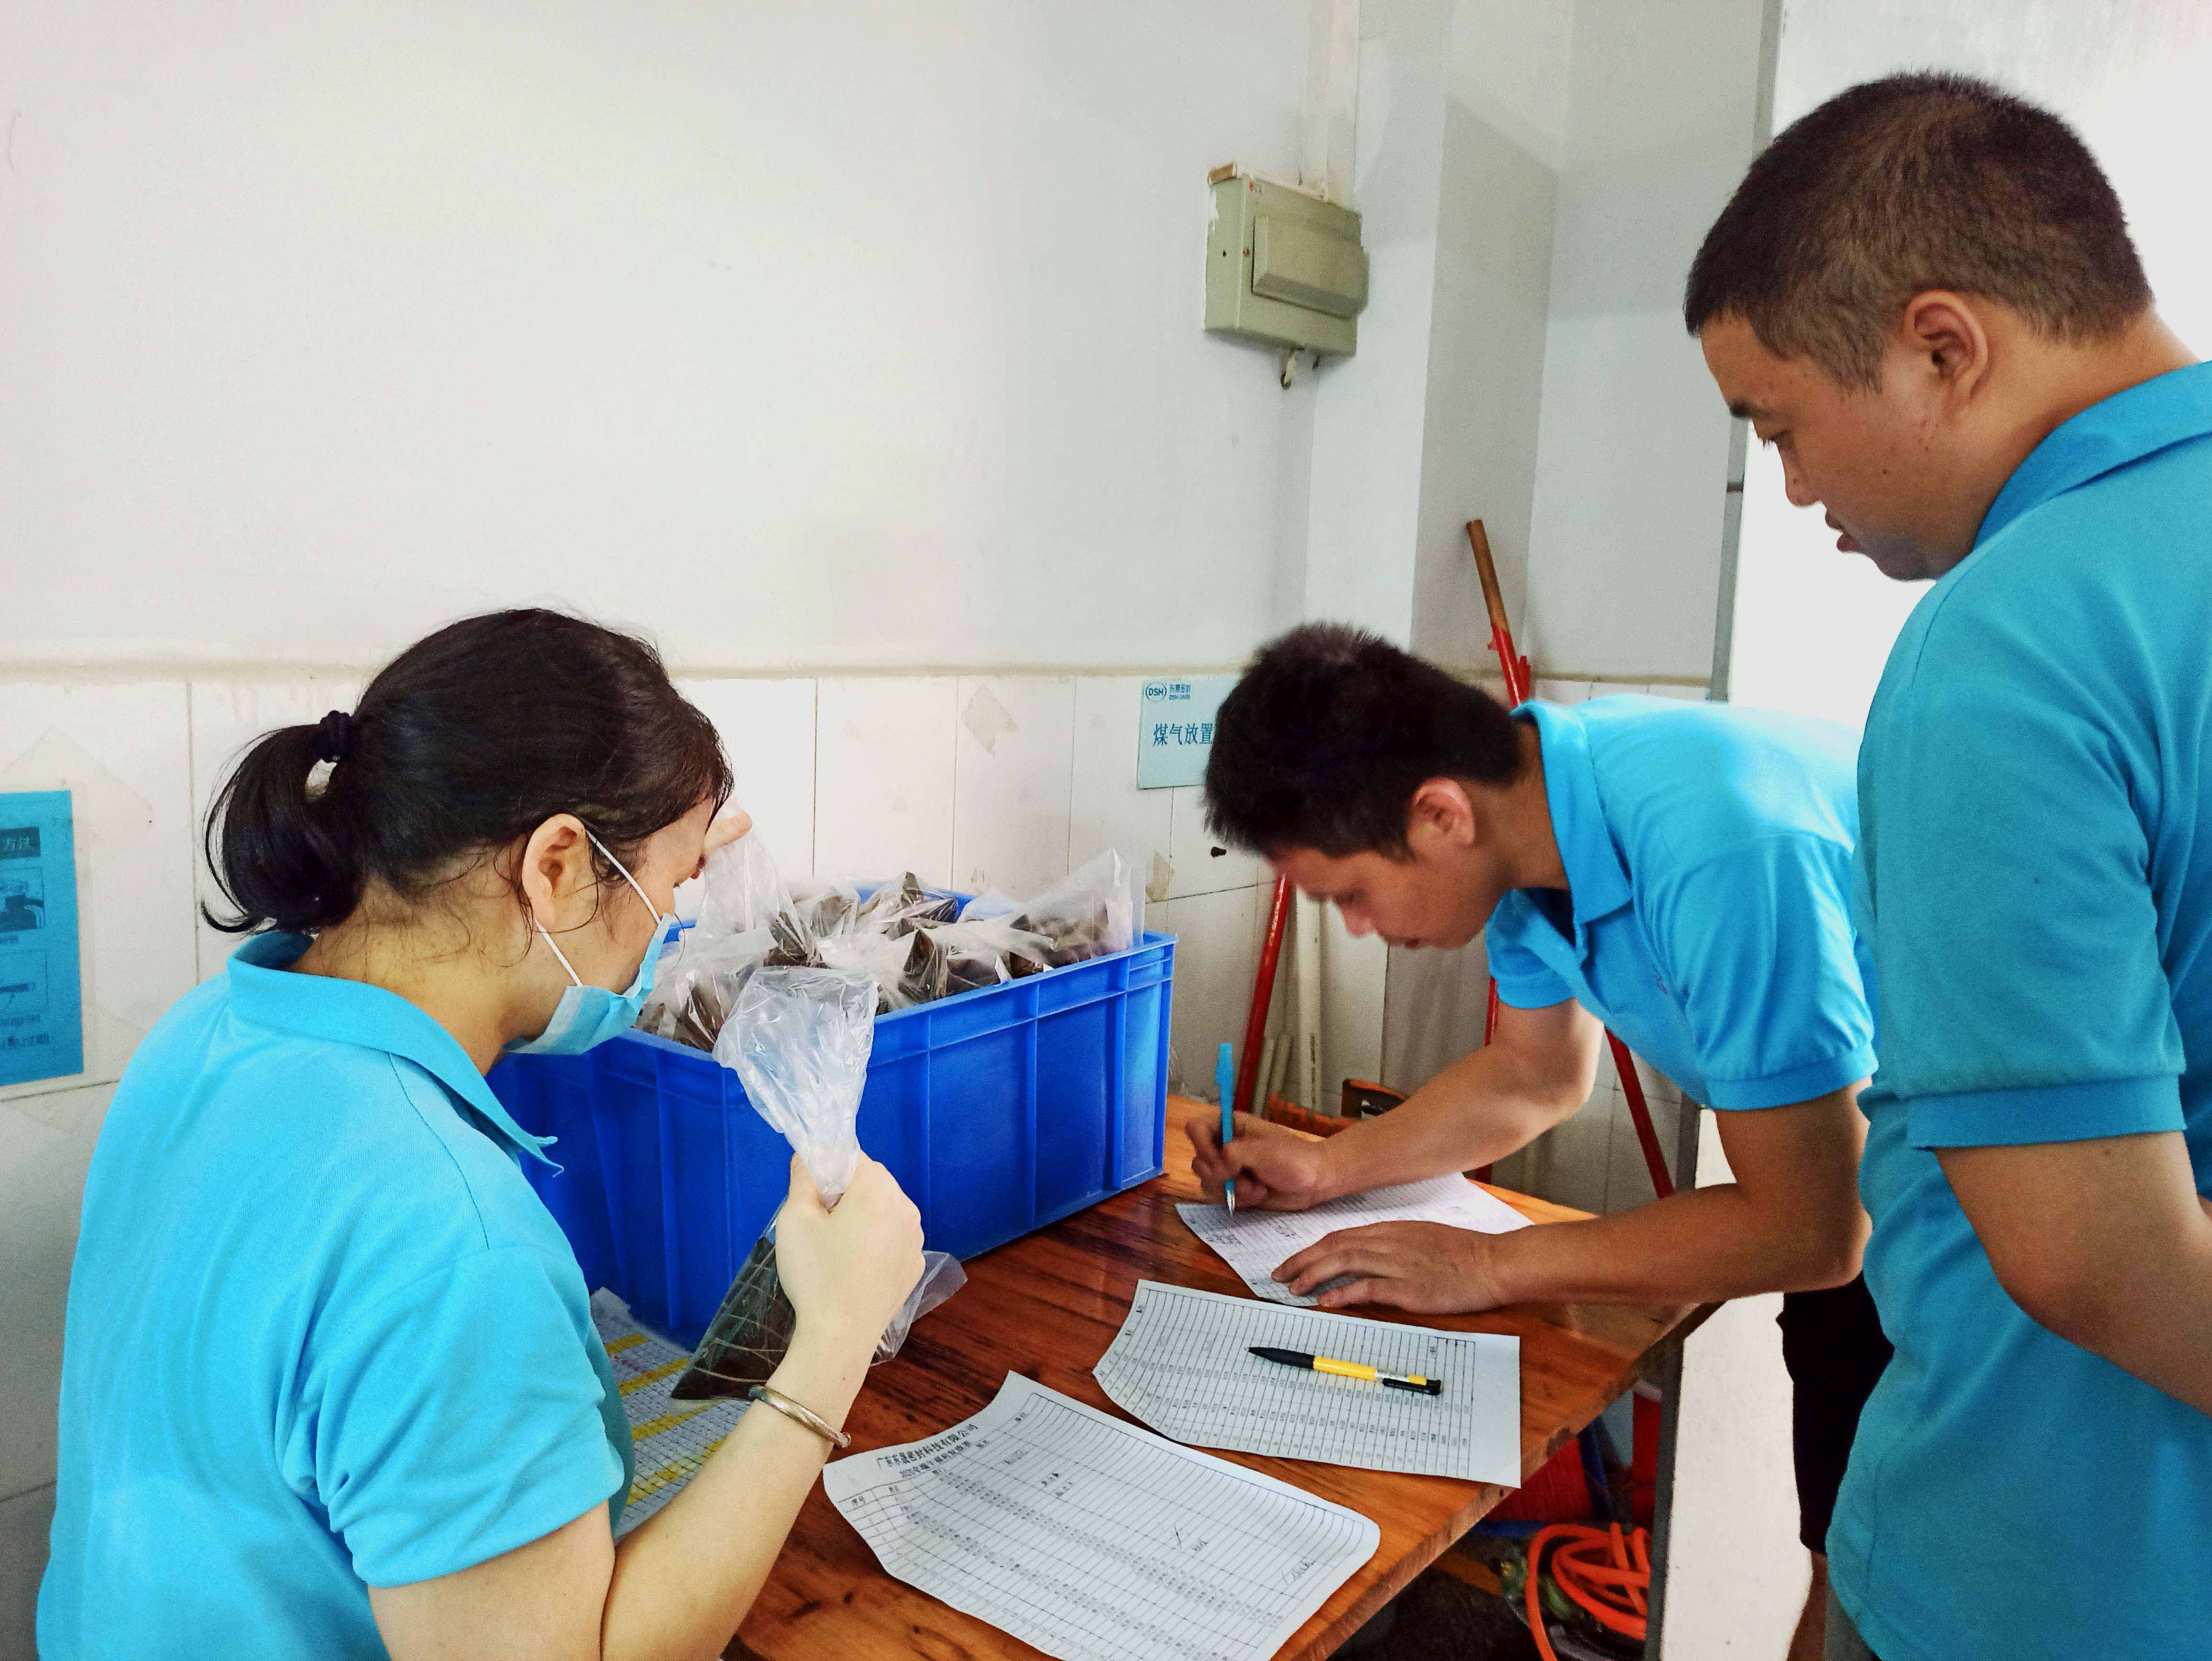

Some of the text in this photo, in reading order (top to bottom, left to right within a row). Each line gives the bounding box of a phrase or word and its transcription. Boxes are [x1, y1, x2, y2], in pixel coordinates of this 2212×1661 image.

[1149, 687, 1164, 697] DSH
[1152, 723, 1213, 746] 煤气放置
